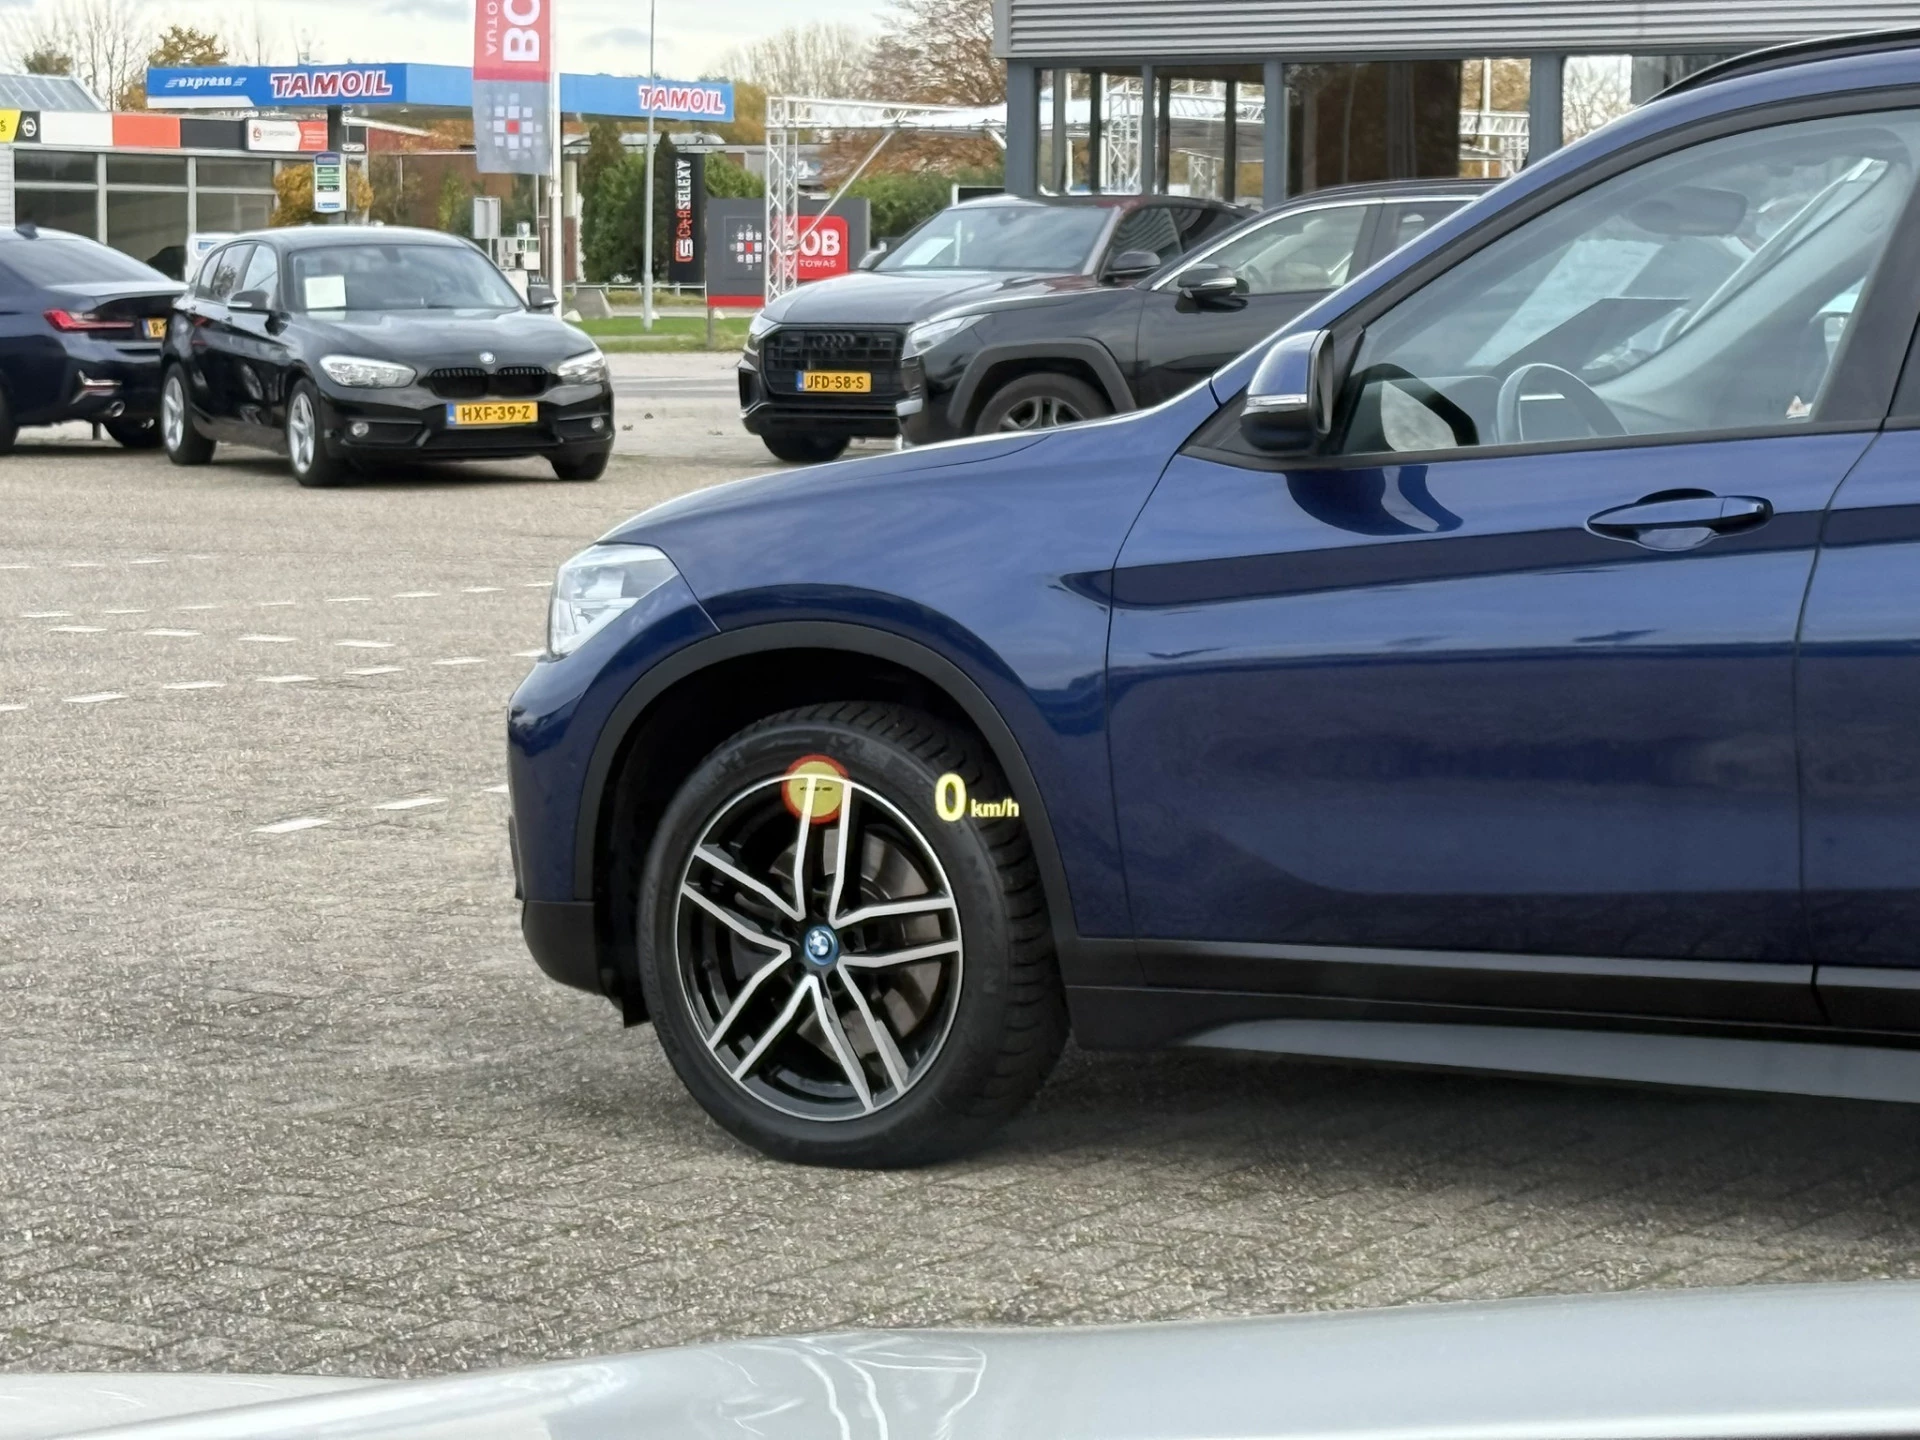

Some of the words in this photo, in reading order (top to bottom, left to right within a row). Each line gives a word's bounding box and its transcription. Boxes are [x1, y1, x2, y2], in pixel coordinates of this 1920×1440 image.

[177, 76, 233, 90] express
[270, 70, 393, 99] TAMOIL
[638, 85, 726, 114] TAMOIL
[784, 229, 840, 256] OB
[806, 375, 865, 389] JFD-58-S
[461, 405, 531, 421] HXF-39-Z
[935, 773, 967, 822] 0
[970, 798, 1020, 818] km/h
